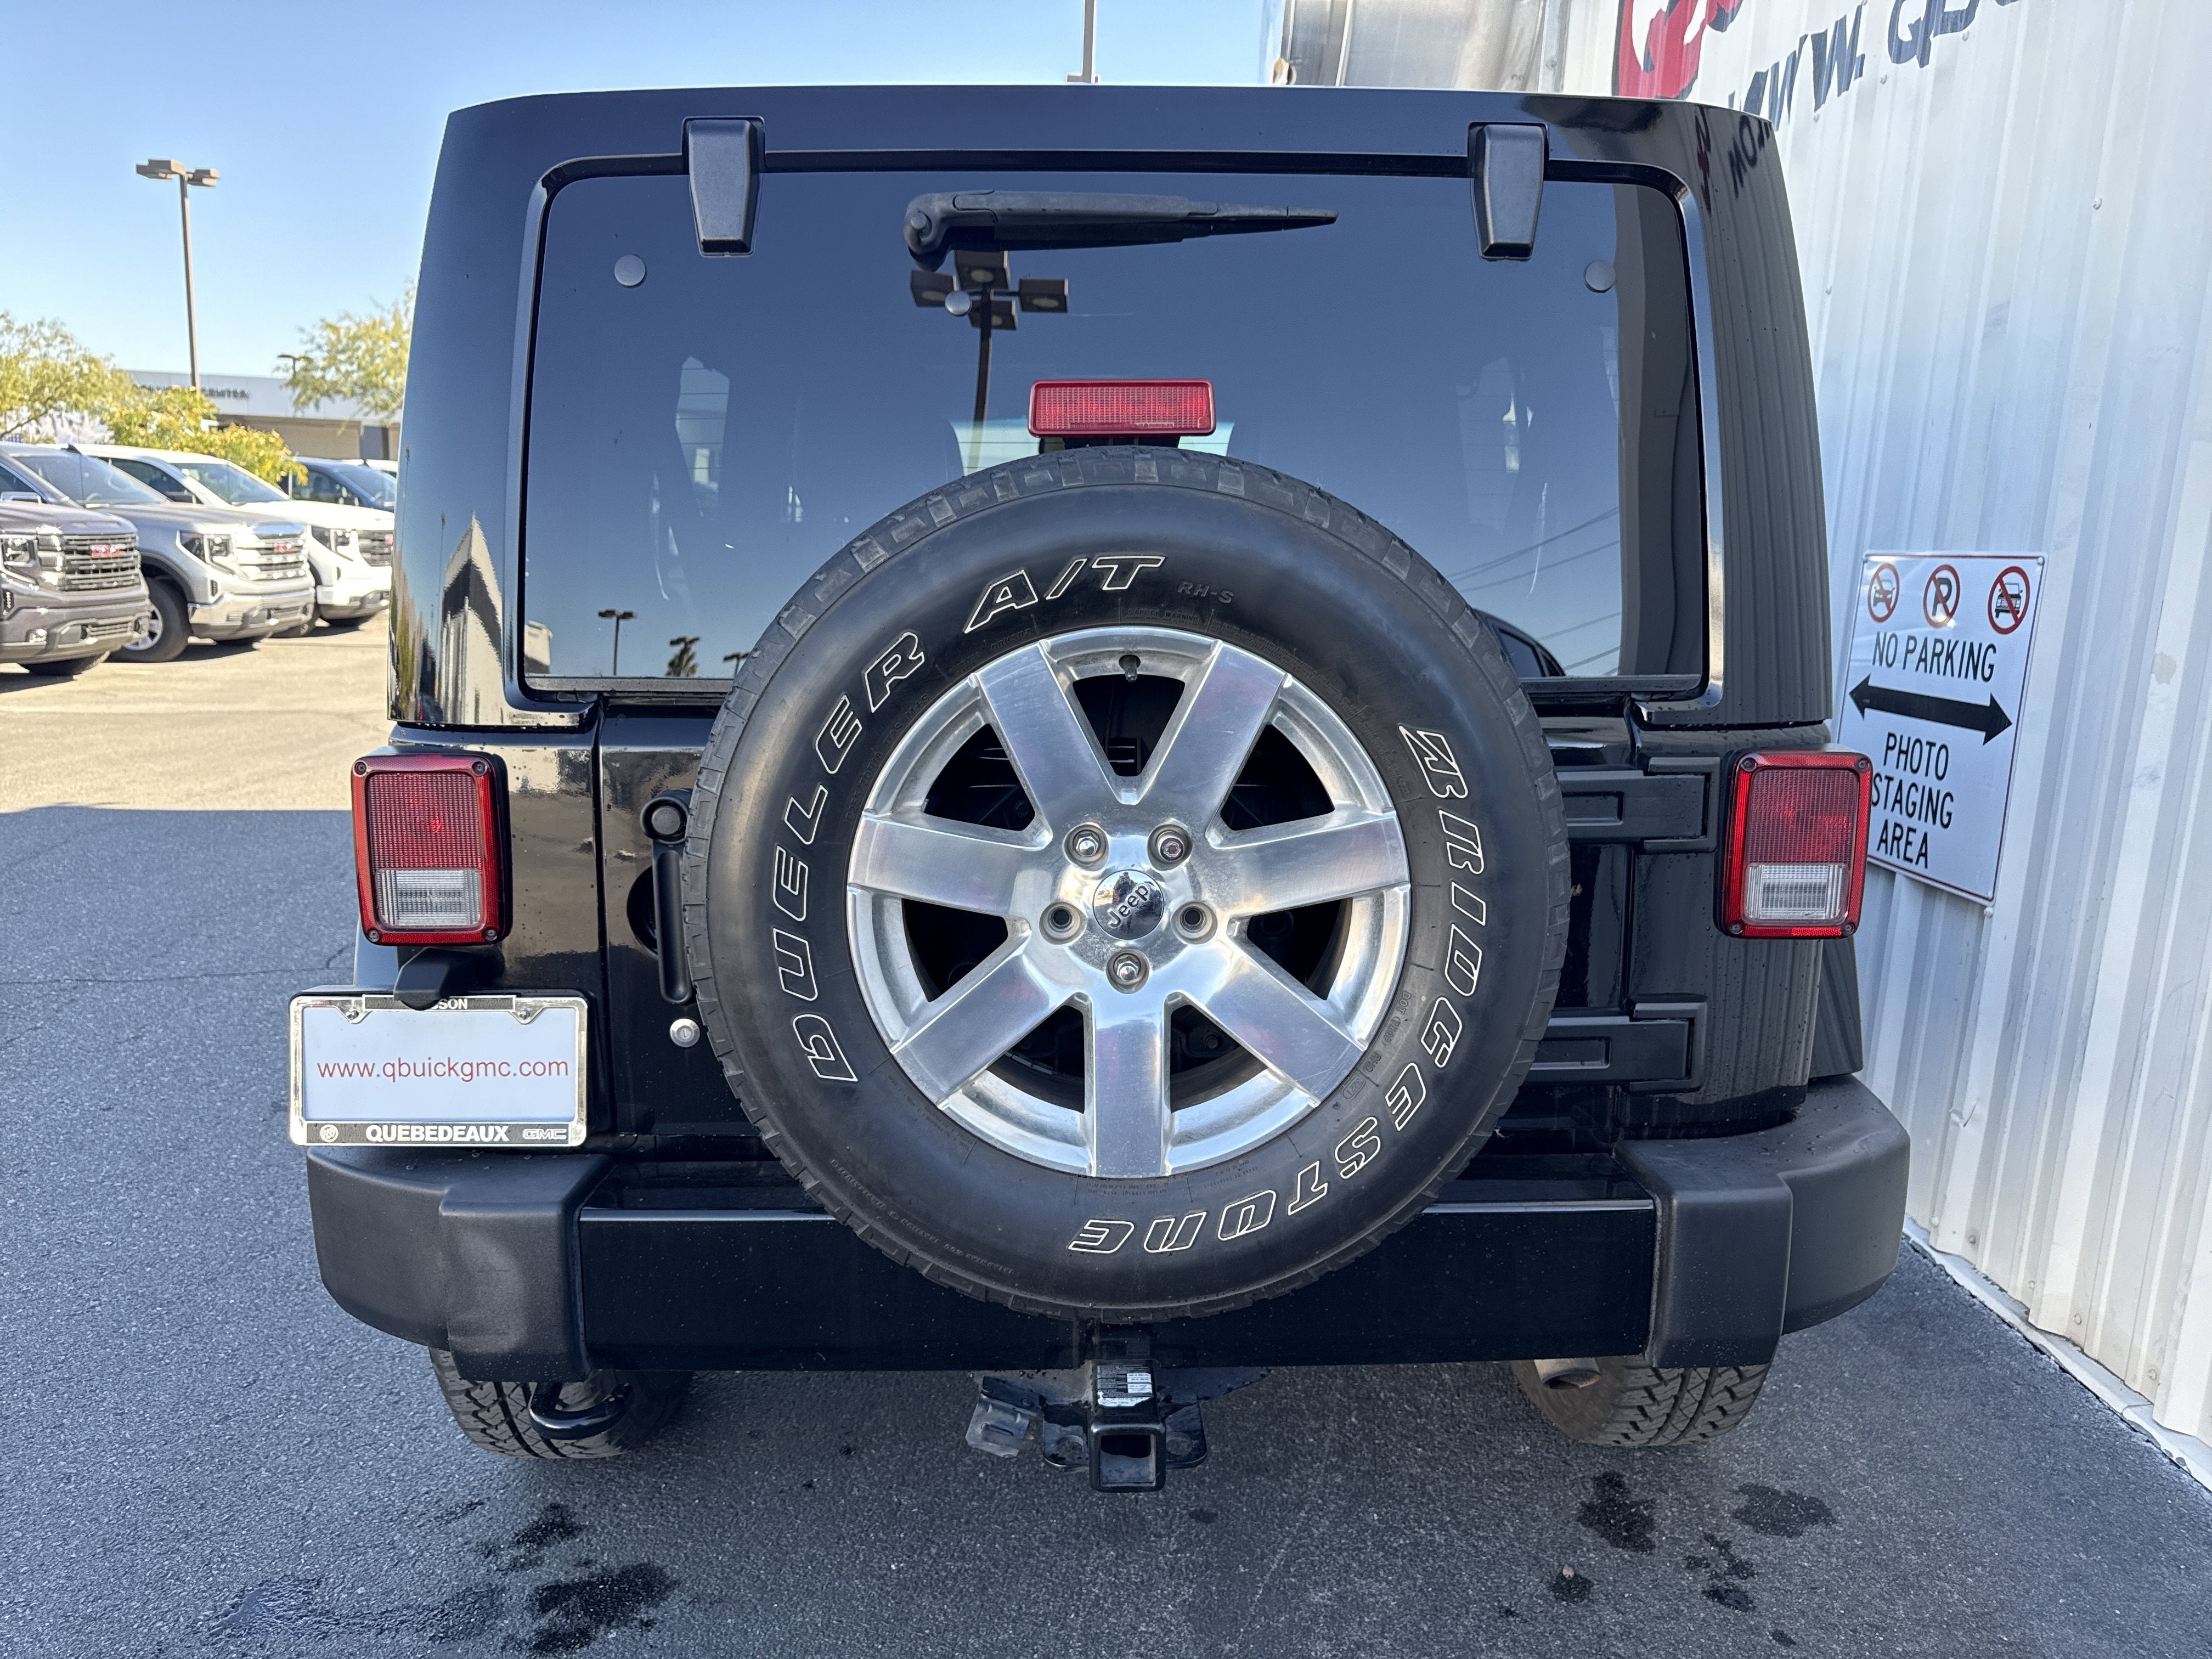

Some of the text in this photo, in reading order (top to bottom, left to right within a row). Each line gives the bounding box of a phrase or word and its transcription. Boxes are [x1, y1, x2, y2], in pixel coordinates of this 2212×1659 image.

[1872, 631, 1997, 682] NO PARKING
[1883, 732, 1949, 781] PHOTO
[773, 632, 924, 1082] DUELER
[964, 556, 1165, 634] A/T
[1176, 580, 1235, 605] RH-S
[1871, 772, 1955, 830] STAGING
[1876, 819, 1929, 870] AREA
[1107, 882, 1150, 929] Jeep
[1068, 725, 1486, 1254] BRIDGESTONE
[1395, 990, 1412, 1015] DOT
[317, 1057, 569, 1082] www.qbuickgmc.com
[365, 1124, 568, 1142] QUEBEDEAUX GMC
